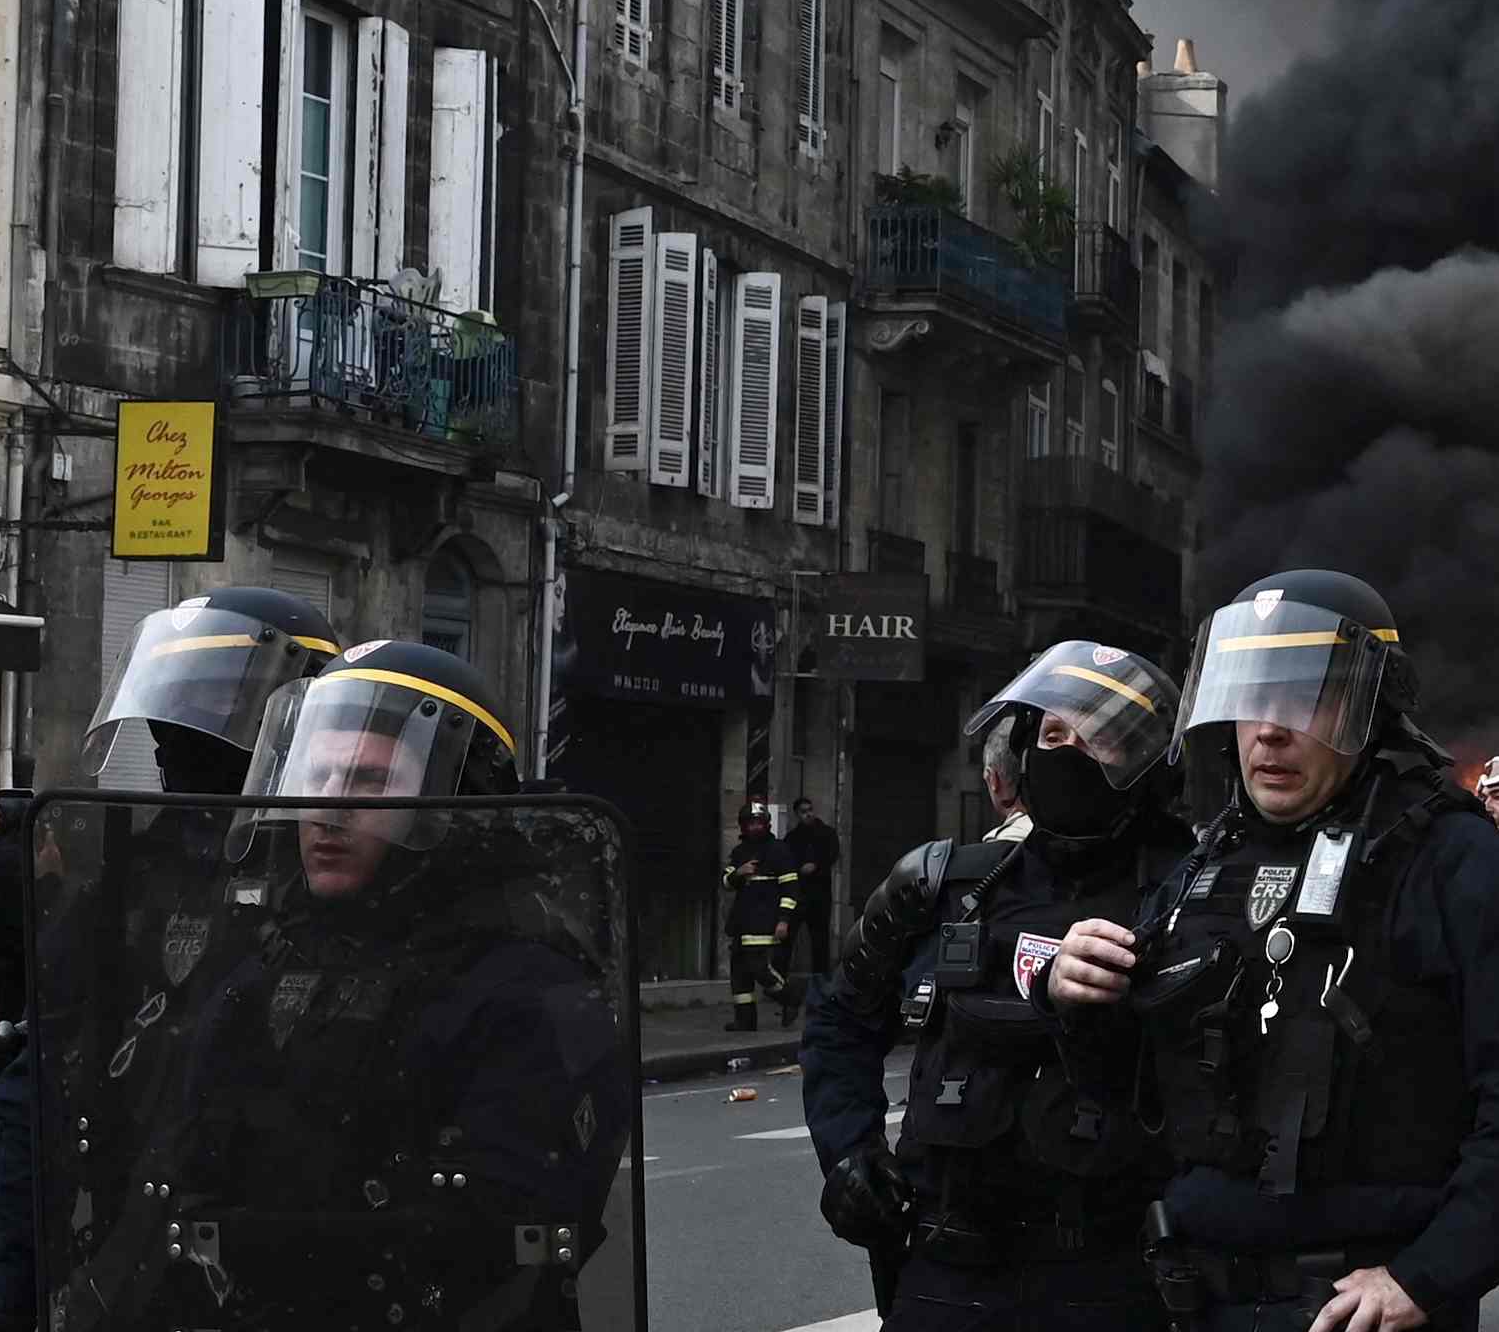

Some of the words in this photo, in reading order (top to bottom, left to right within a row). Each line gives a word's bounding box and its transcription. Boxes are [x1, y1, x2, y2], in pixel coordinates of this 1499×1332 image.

[146, 420, 188, 455] Chez
[125, 459, 205, 481] Milton
[130, 483, 198, 510] Georges
[152, 519, 172, 527] BAR
[129, 529, 192, 540] RESTAURANT
[826, 614, 918, 639] HAIR
[1251, 884, 1289, 898] CRS
